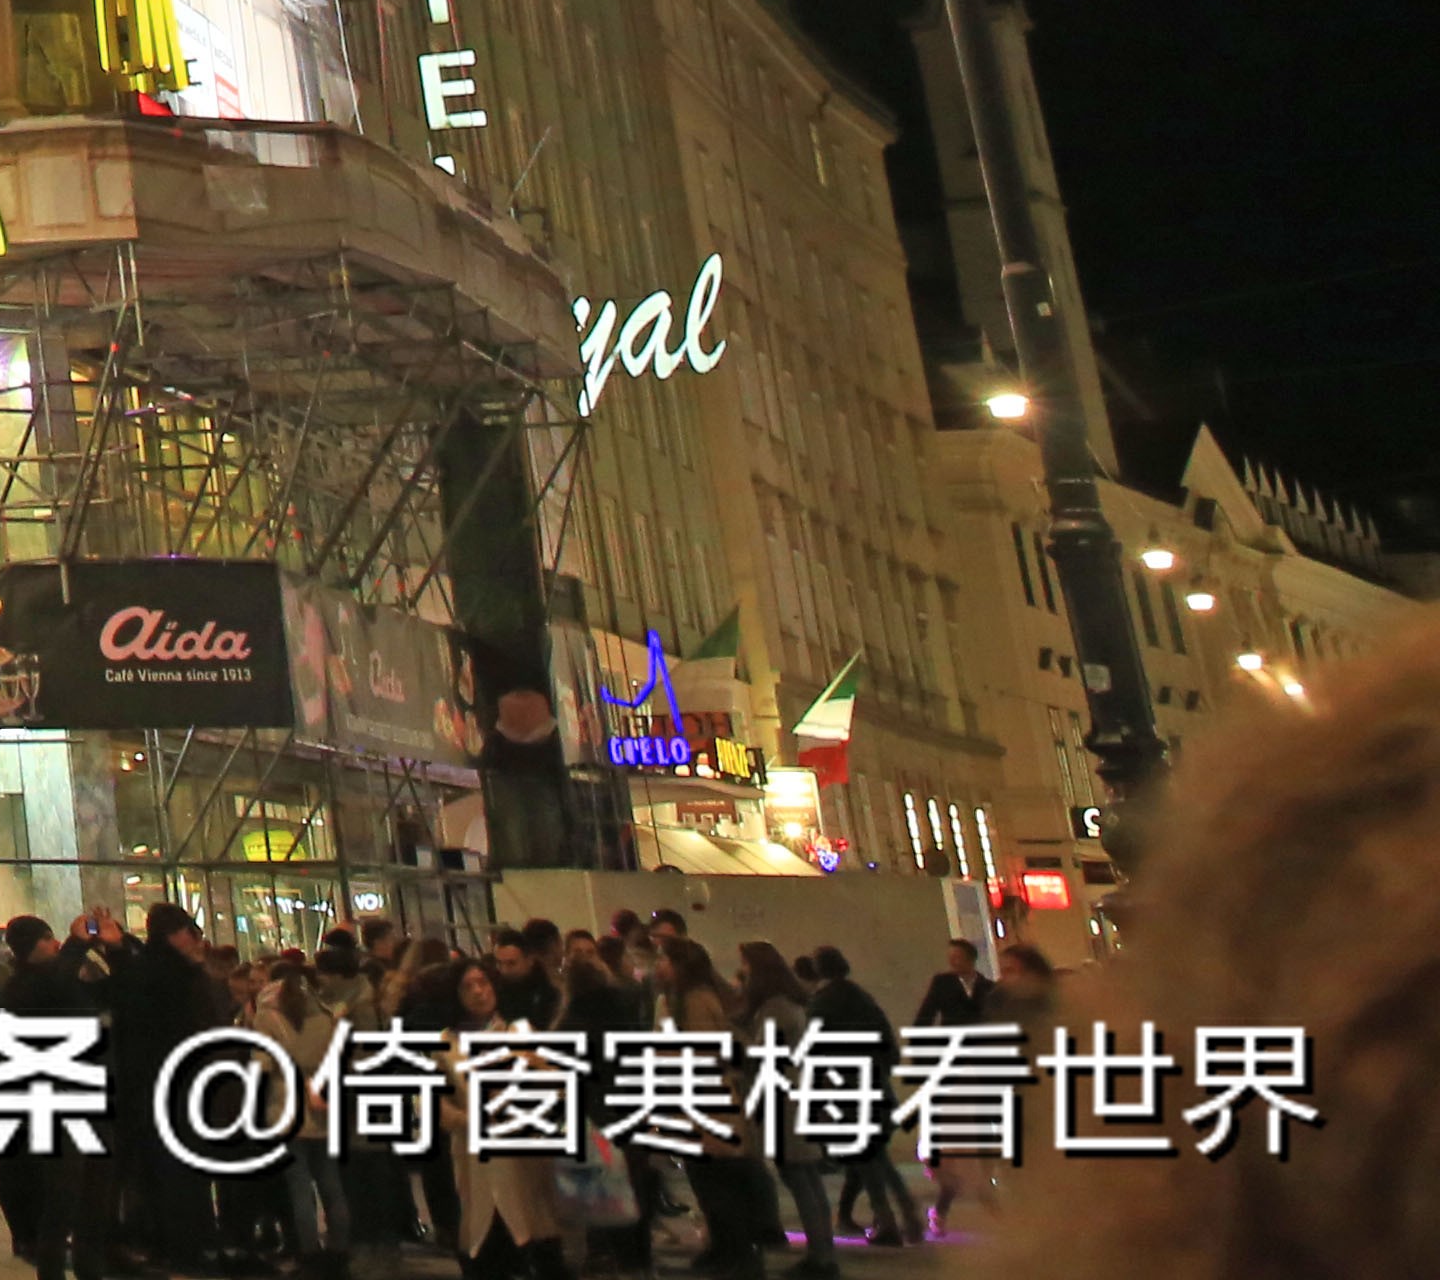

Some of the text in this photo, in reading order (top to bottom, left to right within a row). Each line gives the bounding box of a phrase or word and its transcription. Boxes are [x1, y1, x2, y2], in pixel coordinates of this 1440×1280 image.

[572, 252, 727, 417] yal
[105, 667, 252, 682] Café Vienna since 1913
